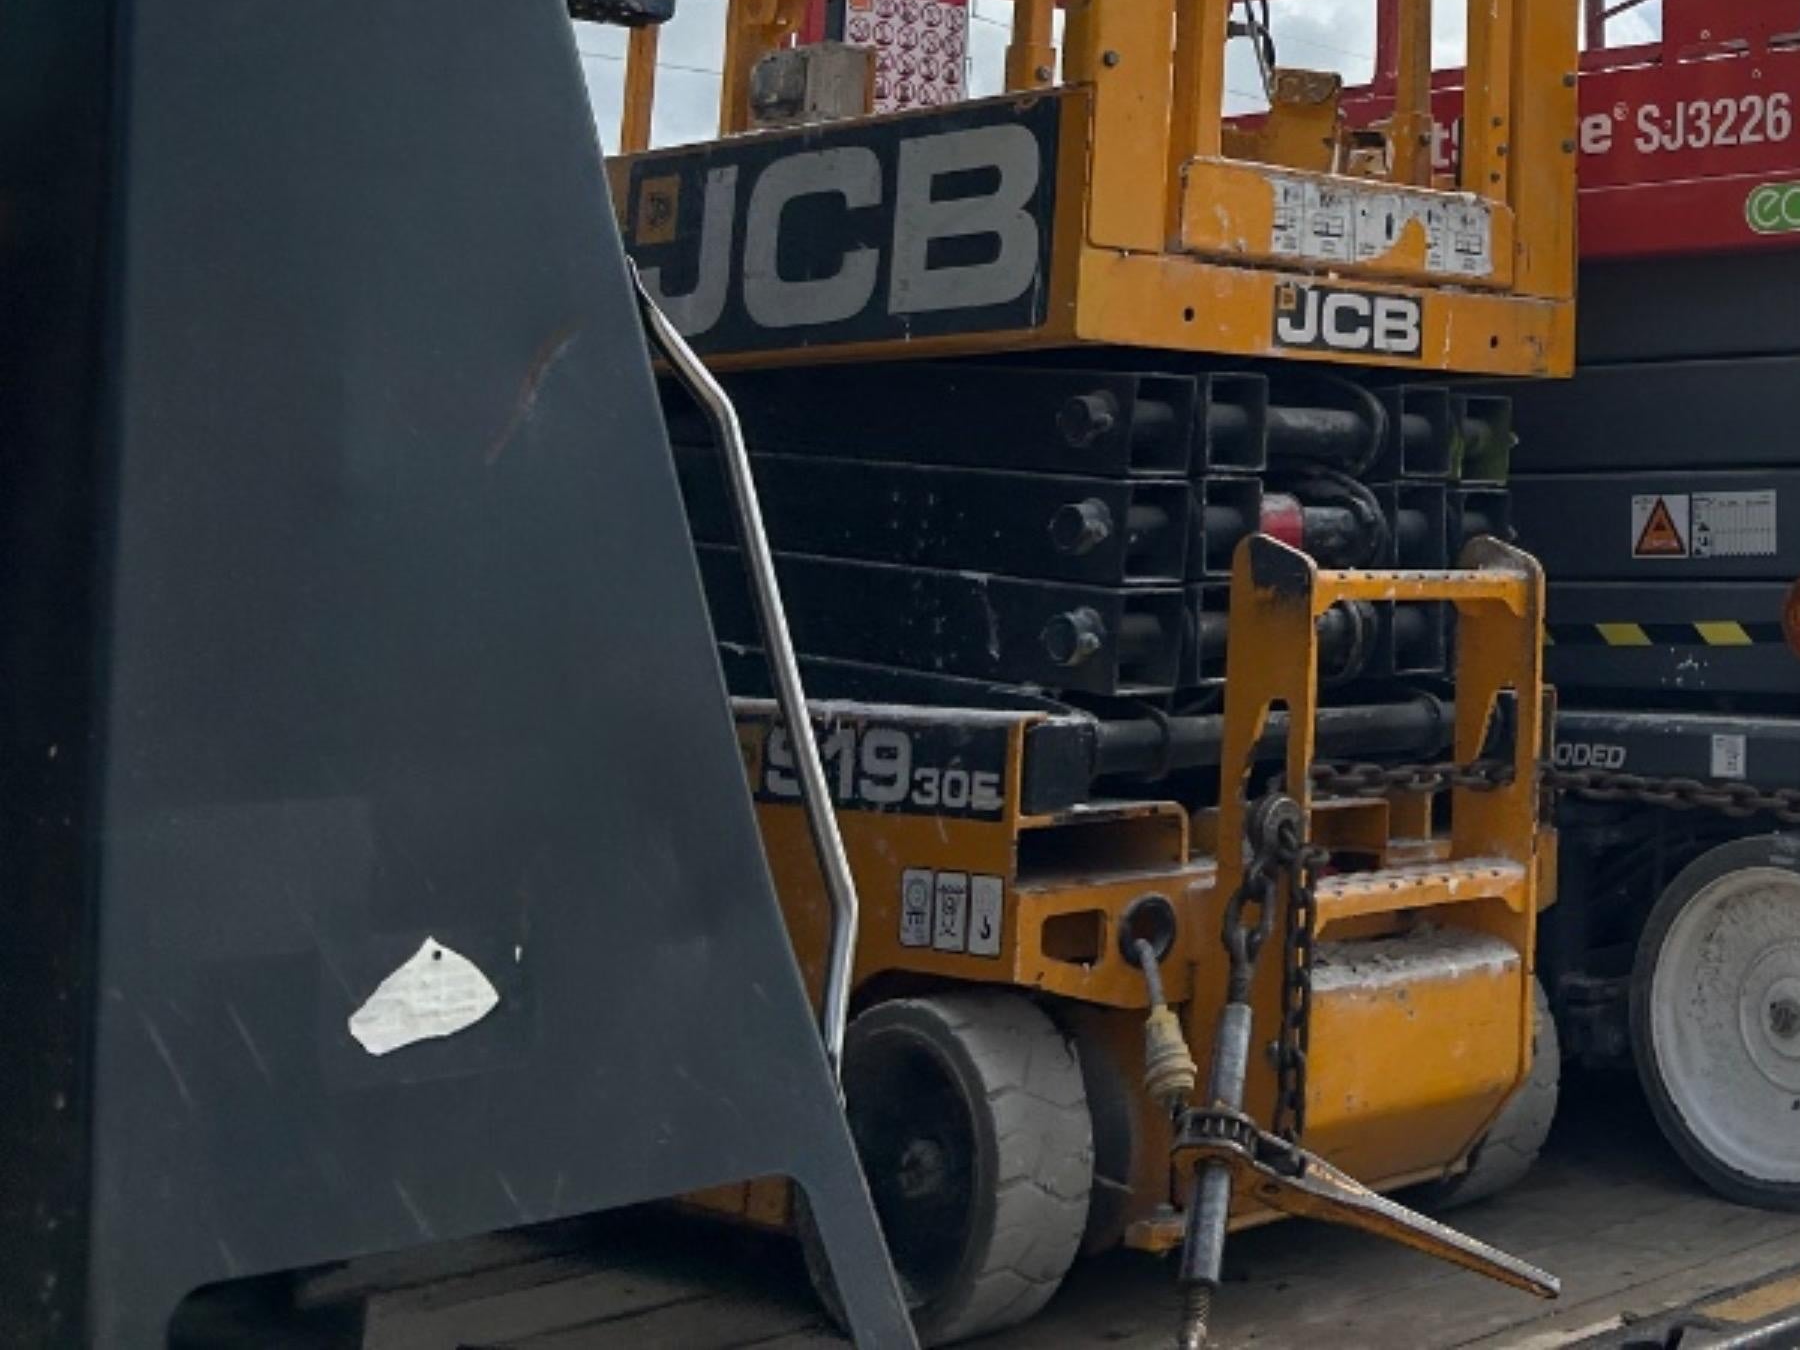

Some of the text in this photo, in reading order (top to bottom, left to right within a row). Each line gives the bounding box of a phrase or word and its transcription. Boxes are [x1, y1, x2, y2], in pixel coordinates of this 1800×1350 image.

[1635, 92, 1792, 153] SJ3226
[641, 123, 1040, 338] JCB
[1277, 289, 1421, 352] JCB
